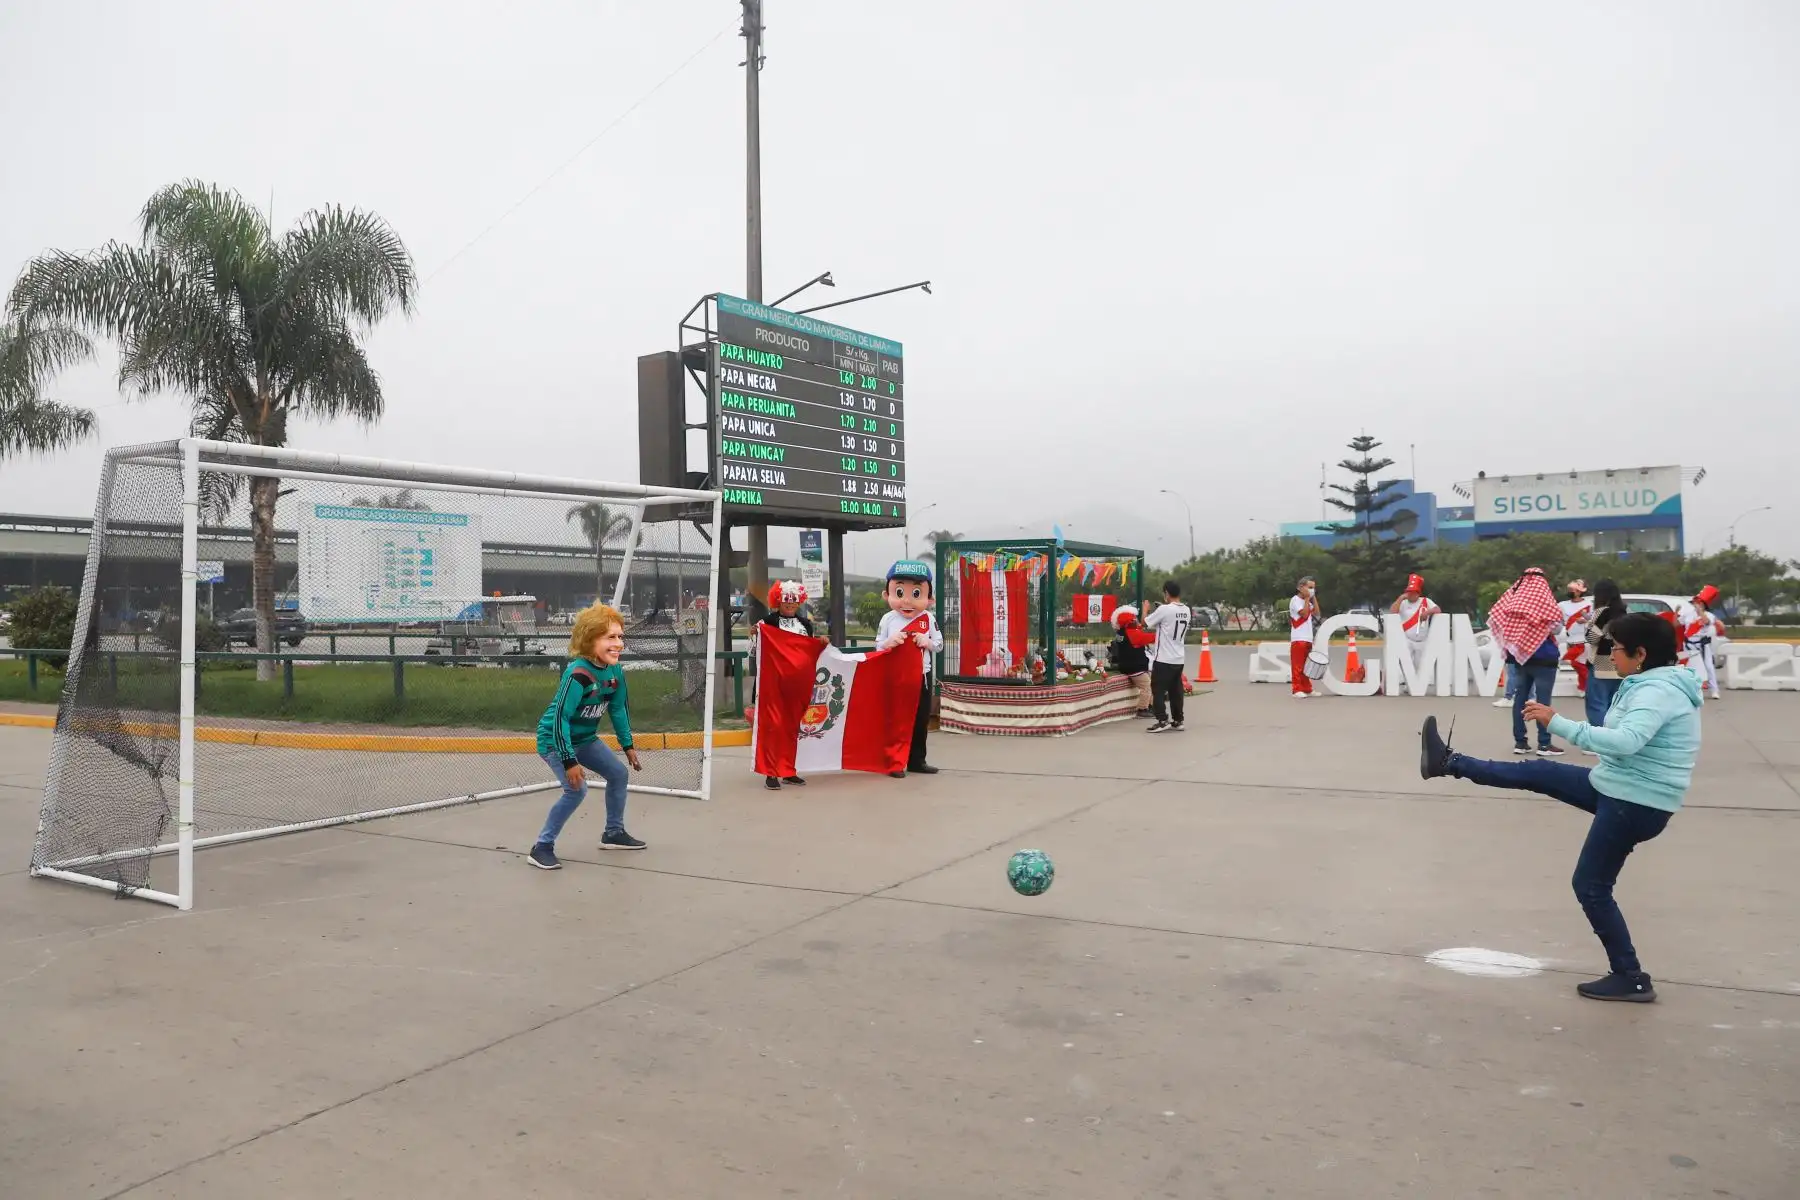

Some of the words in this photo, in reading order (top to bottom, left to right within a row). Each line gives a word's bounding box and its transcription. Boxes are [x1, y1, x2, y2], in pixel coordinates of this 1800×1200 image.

[742, 302, 768, 319] GRAN
[770, 310, 812, 331] MERCADO
[814, 323, 858, 342] MAYORISTA
[858, 336, 868, 346] DE
[868, 339, 887, 351] LIMA
[756, 327, 810, 352] PRODUCTO
[720, 343, 744, 362] PAPA
[746, 349, 783, 370] HUAYRO
[840, 371, 854, 386] 1.60
[861, 374, 877, 390] 2.00
[889, 382, 895, 394] D
[840, 358, 854, 370] MIN
[860, 363, 876, 375] MAX
[882, 360, 899, 374] PAB
[720, 367, 744, 386] PAPA
[747, 372, 777, 392] NEGRA
[840, 392, 854, 407] 1.30
[862, 396, 876, 412] 1.70
[890, 402, 896, 414] D
[721, 392, 746, 410] PAPA
[748, 396, 796, 418] PERUANITA
[840, 414, 855, 428] 1.70
[864, 418, 877, 432] 2.10
[890, 424, 896, 436] D
[722, 415, 746, 432] PAPA
[748, 420, 776, 437] UNICA
[841, 434, 856, 450] 1.30
[863, 438, 877, 452] 1.50
[890, 443, 896, 456] D
[722, 440, 746, 456] PAPA
[748, 444, 785, 462] YUNGAY
[842, 456, 856, 472] 1.20
[864, 460, 878, 474] 1.50
[891, 464, 897, 476] D
[723, 464, 758, 482] PAPAYA
[760, 468, 786, 486] SELVA
[842, 478, 856, 493] 1.88
[864, 482, 879, 496] 2.50
[724, 488, 762, 506] PAPRIKA
[840, 500, 859, 514] 13.00
[862, 502, 881, 516] 14.00
[892, 506, 898, 517] A
[1494, 494, 1567, 514] SISOL
[1578, 488, 1658, 511] SALUD
[1172, 620, 1188, 642] 17
